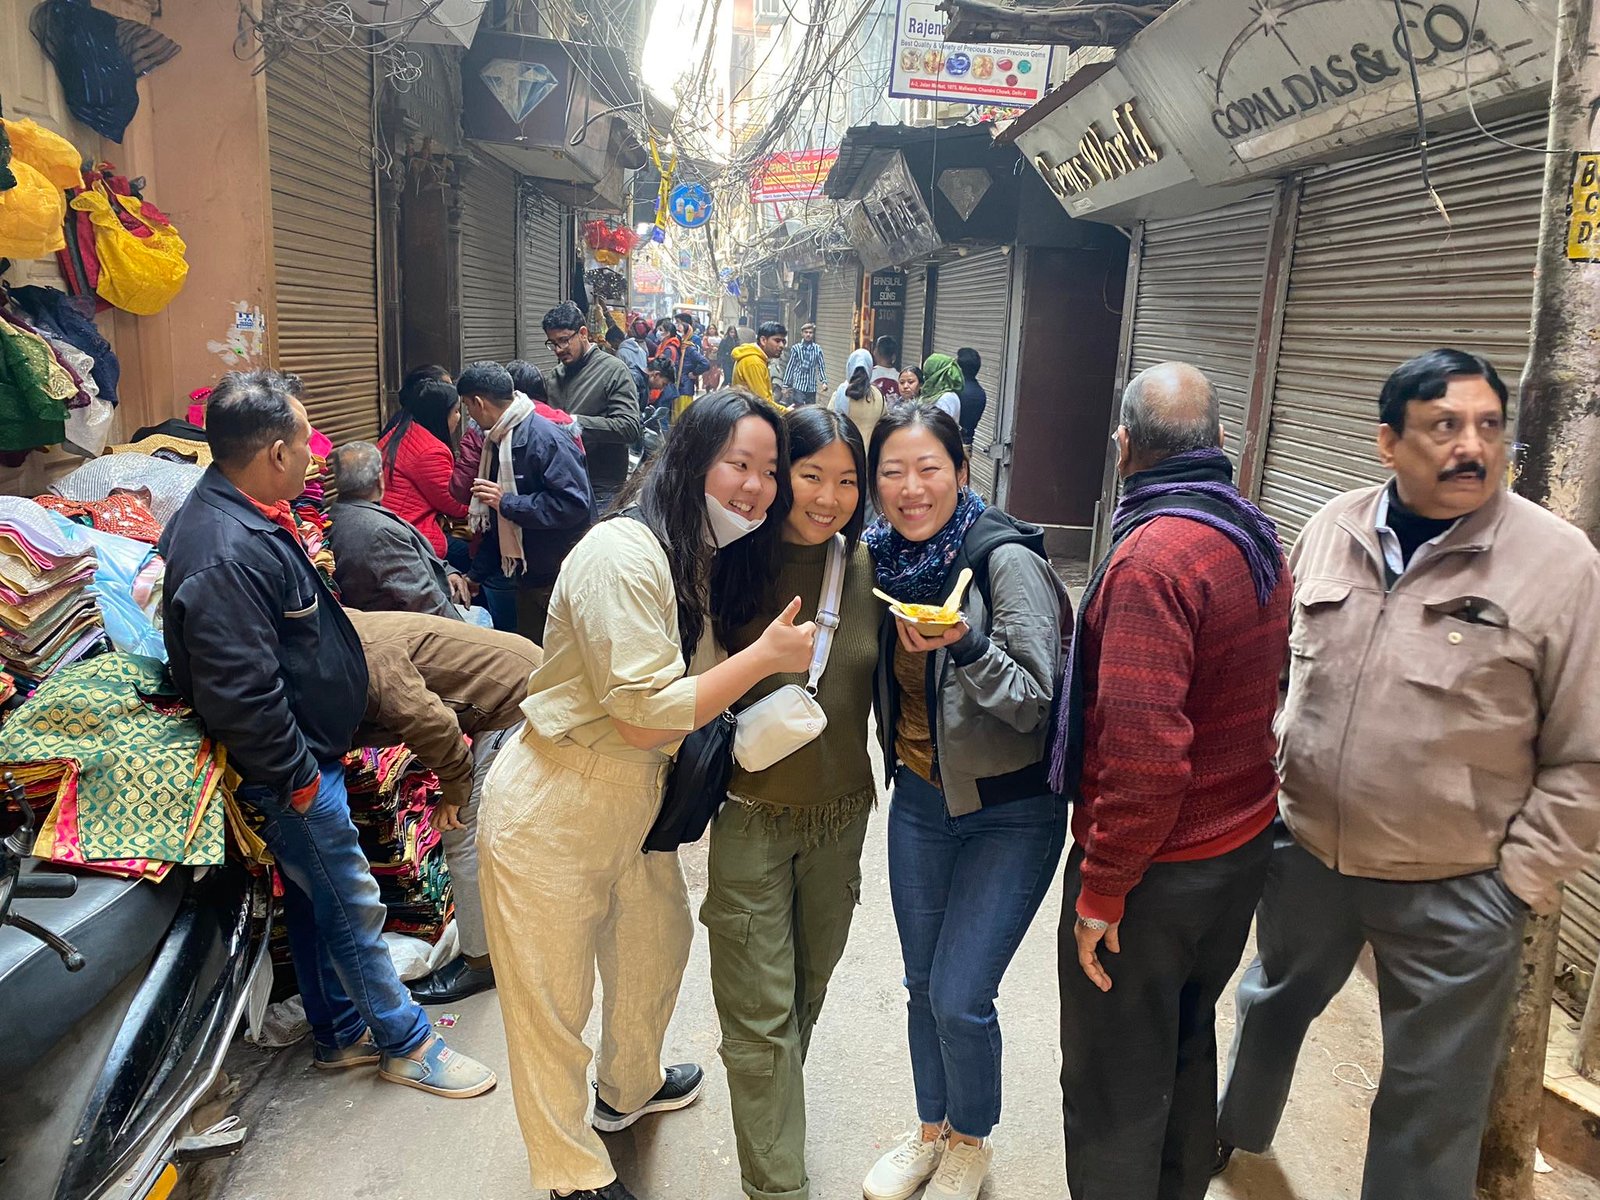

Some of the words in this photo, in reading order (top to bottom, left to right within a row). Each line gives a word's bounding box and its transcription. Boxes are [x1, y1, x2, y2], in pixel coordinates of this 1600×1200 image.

[914, 41, 931, 50] Quality
[964, 45, 986, 53] Precious
[1079, 100, 1161, 181] World
[880, 291, 896, 300] SONS
